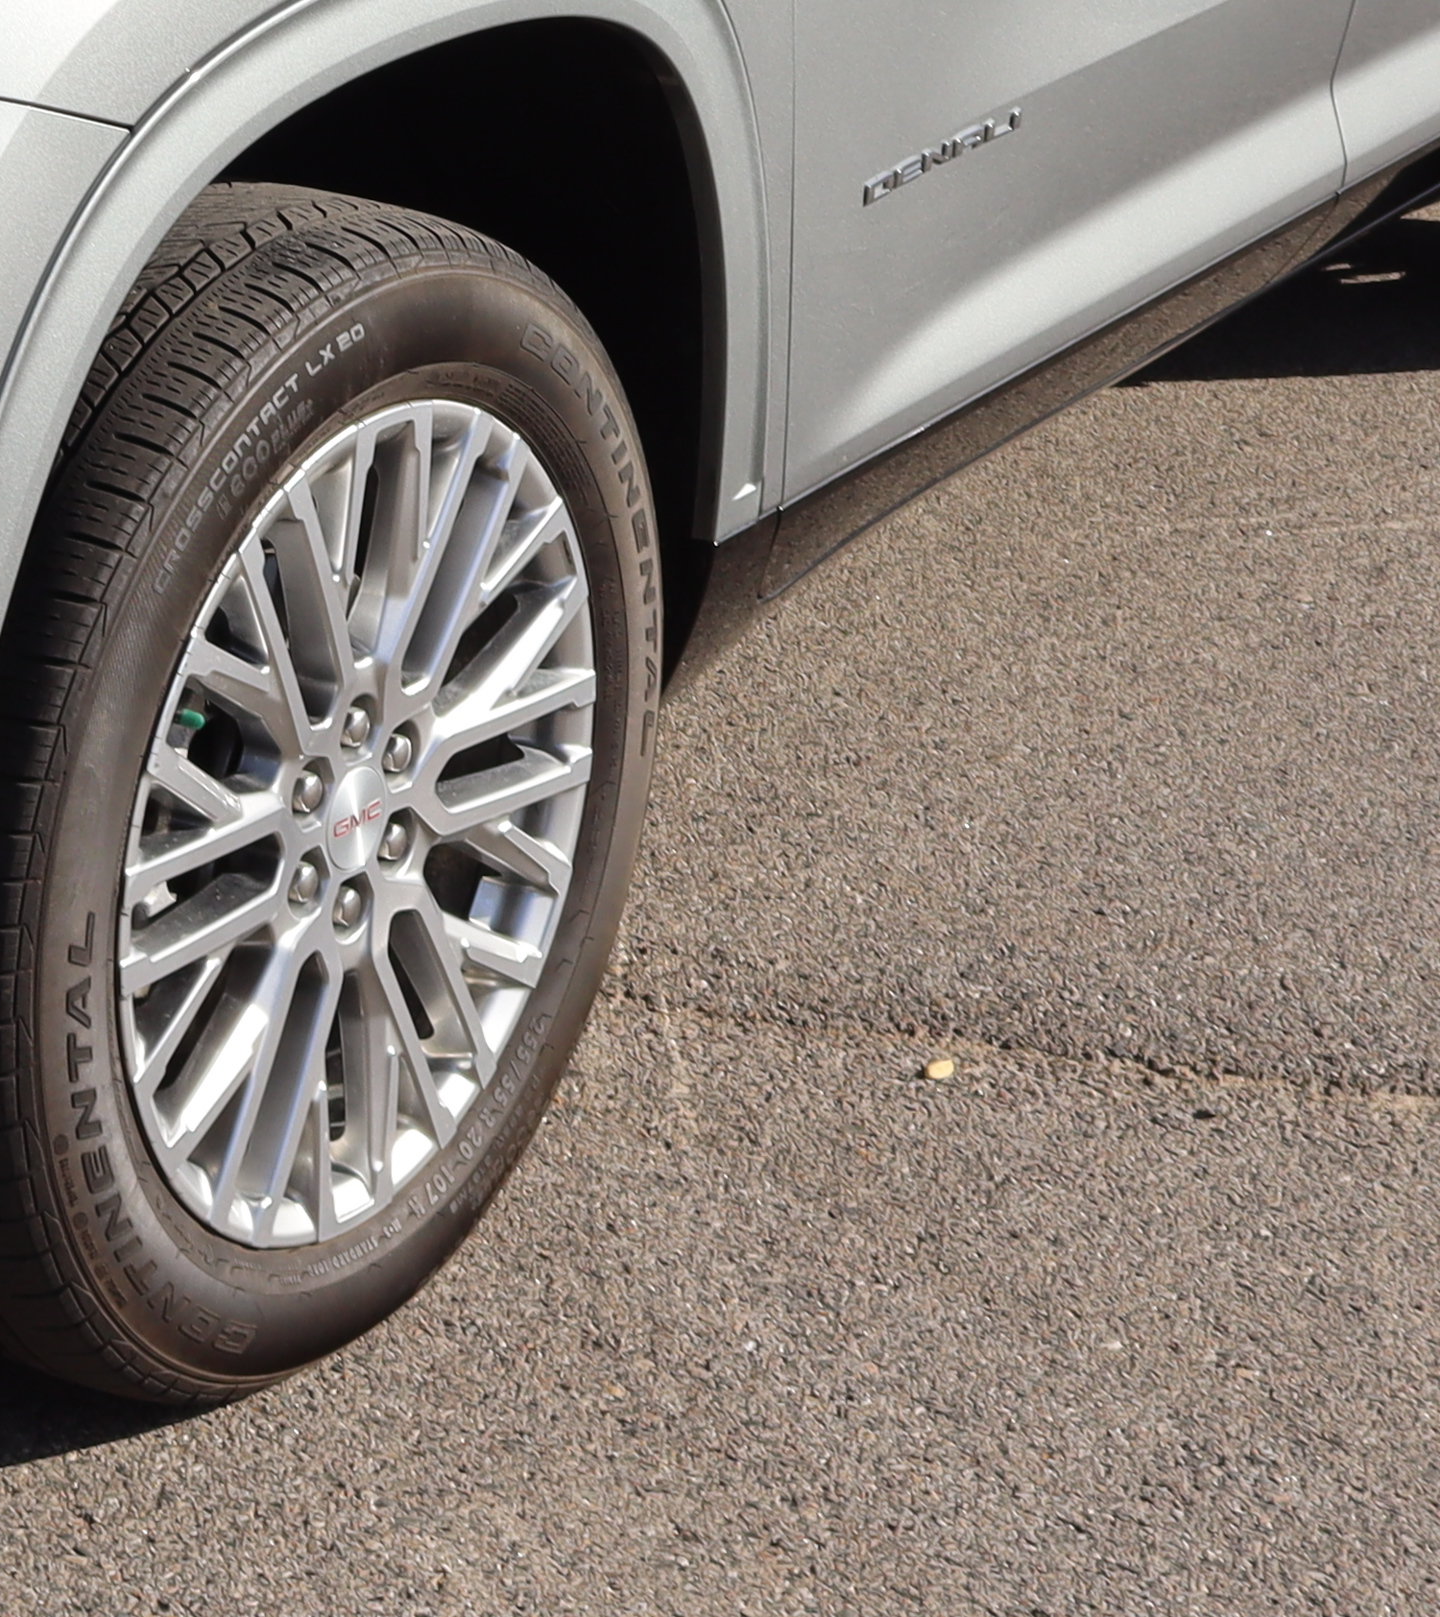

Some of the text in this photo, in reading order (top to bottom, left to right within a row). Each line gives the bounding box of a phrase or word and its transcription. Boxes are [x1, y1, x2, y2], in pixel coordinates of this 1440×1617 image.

[862, 105, 1022, 207] DENALI
[154, 372, 300, 595] CROSSCONTACT
[520, 321, 658, 757] CONTINENTAL
[332, 799, 383, 839] GMC
[66, 911, 258, 1356] CONTINENTAL
